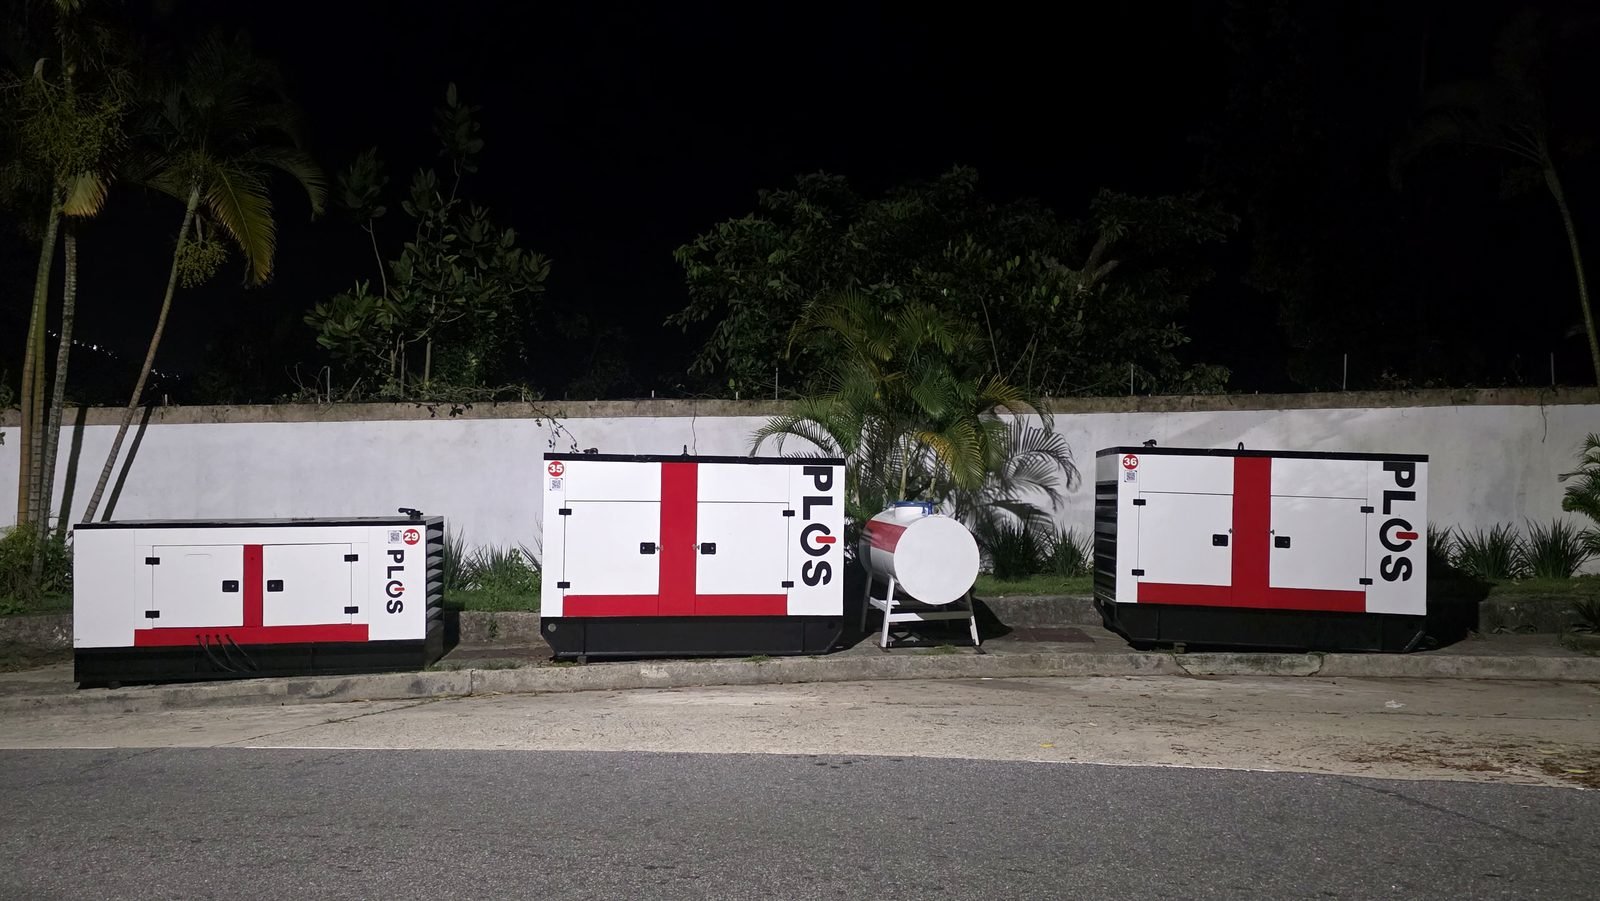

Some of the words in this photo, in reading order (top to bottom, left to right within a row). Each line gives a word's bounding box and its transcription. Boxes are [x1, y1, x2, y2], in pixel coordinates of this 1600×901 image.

[549, 464, 563, 473] 35
[1123, 457, 1137, 466] 36
[404, 532, 419, 541] 29
[800, 466, 837, 587] PLOS
[1379, 461, 1419, 582] PLOS
[386, 549, 405, 614] PLOS
